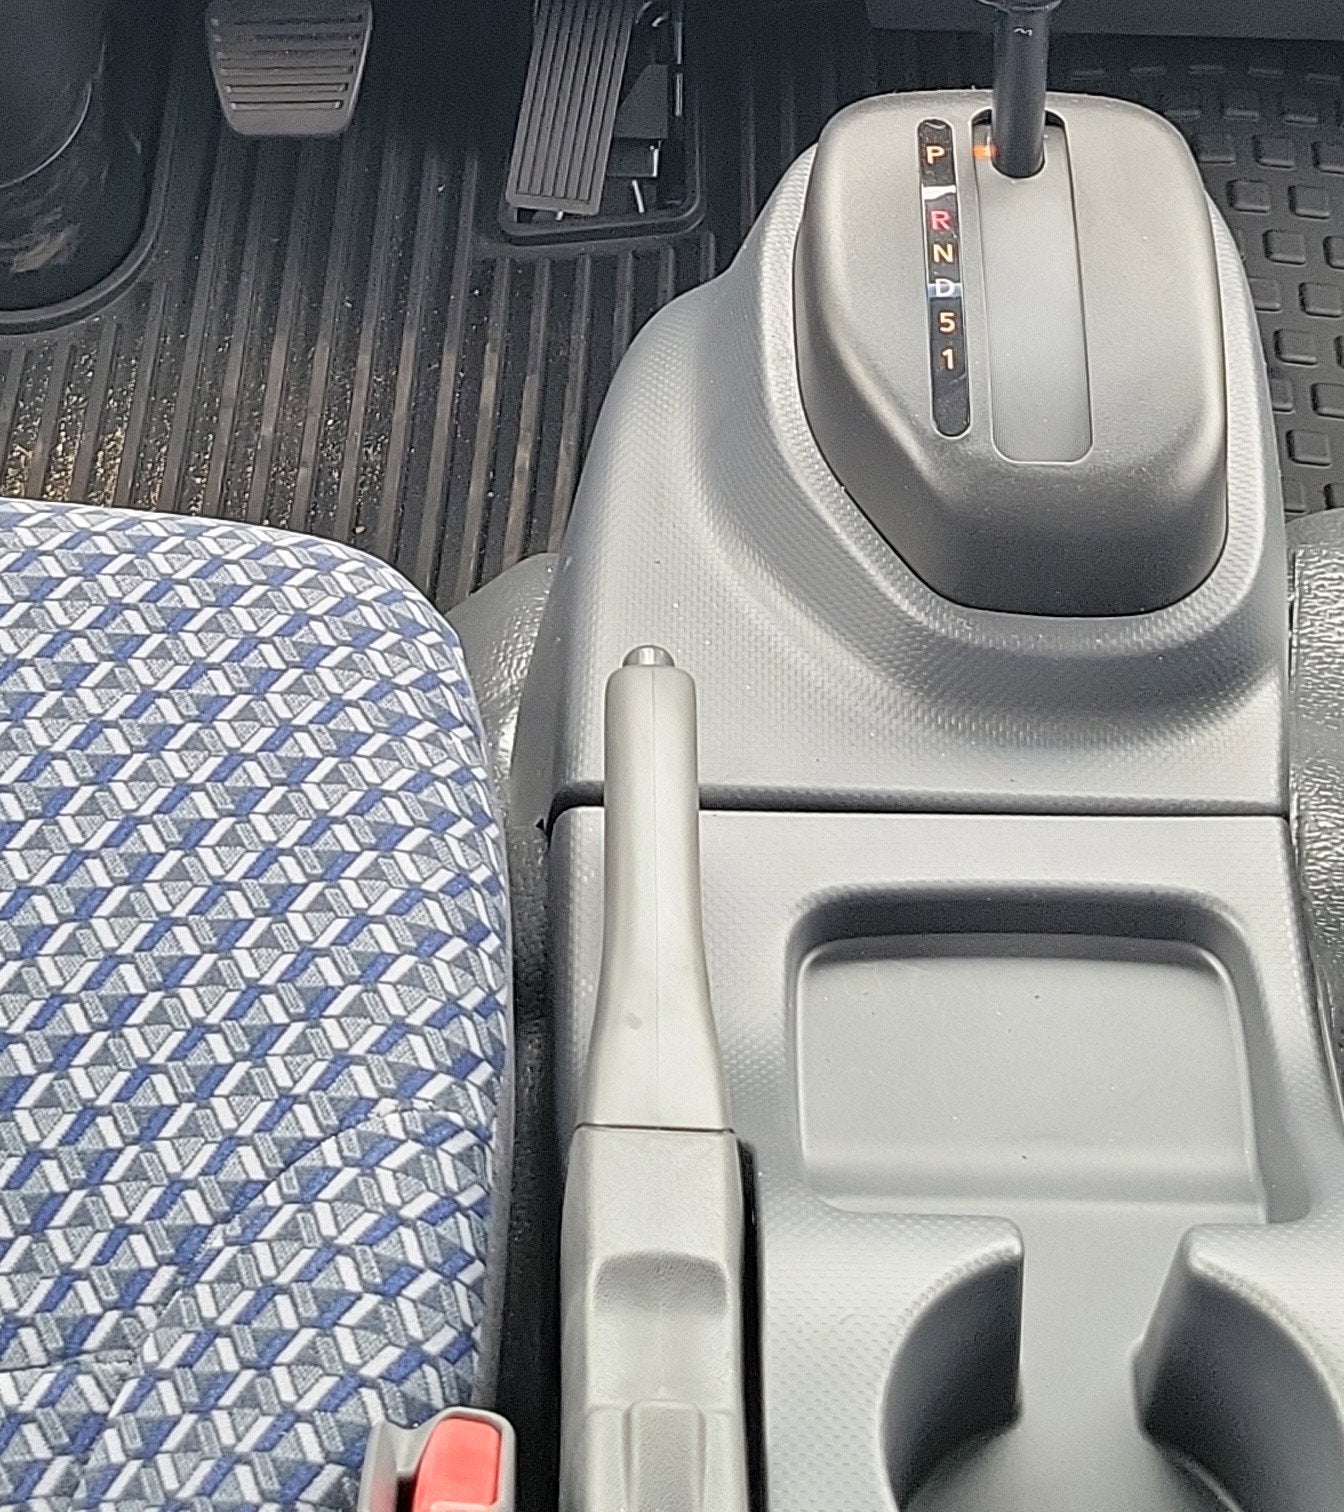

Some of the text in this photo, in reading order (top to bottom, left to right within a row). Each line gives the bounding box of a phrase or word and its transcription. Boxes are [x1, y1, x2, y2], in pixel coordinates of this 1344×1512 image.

[926, 145, 945, 165] P
[931, 210, 950, 230] R
[933, 243, 953, 264] N
[935, 278, 955, 297] D
[940, 312, 956, 332] 5
[942, 348, 954, 369] 1
